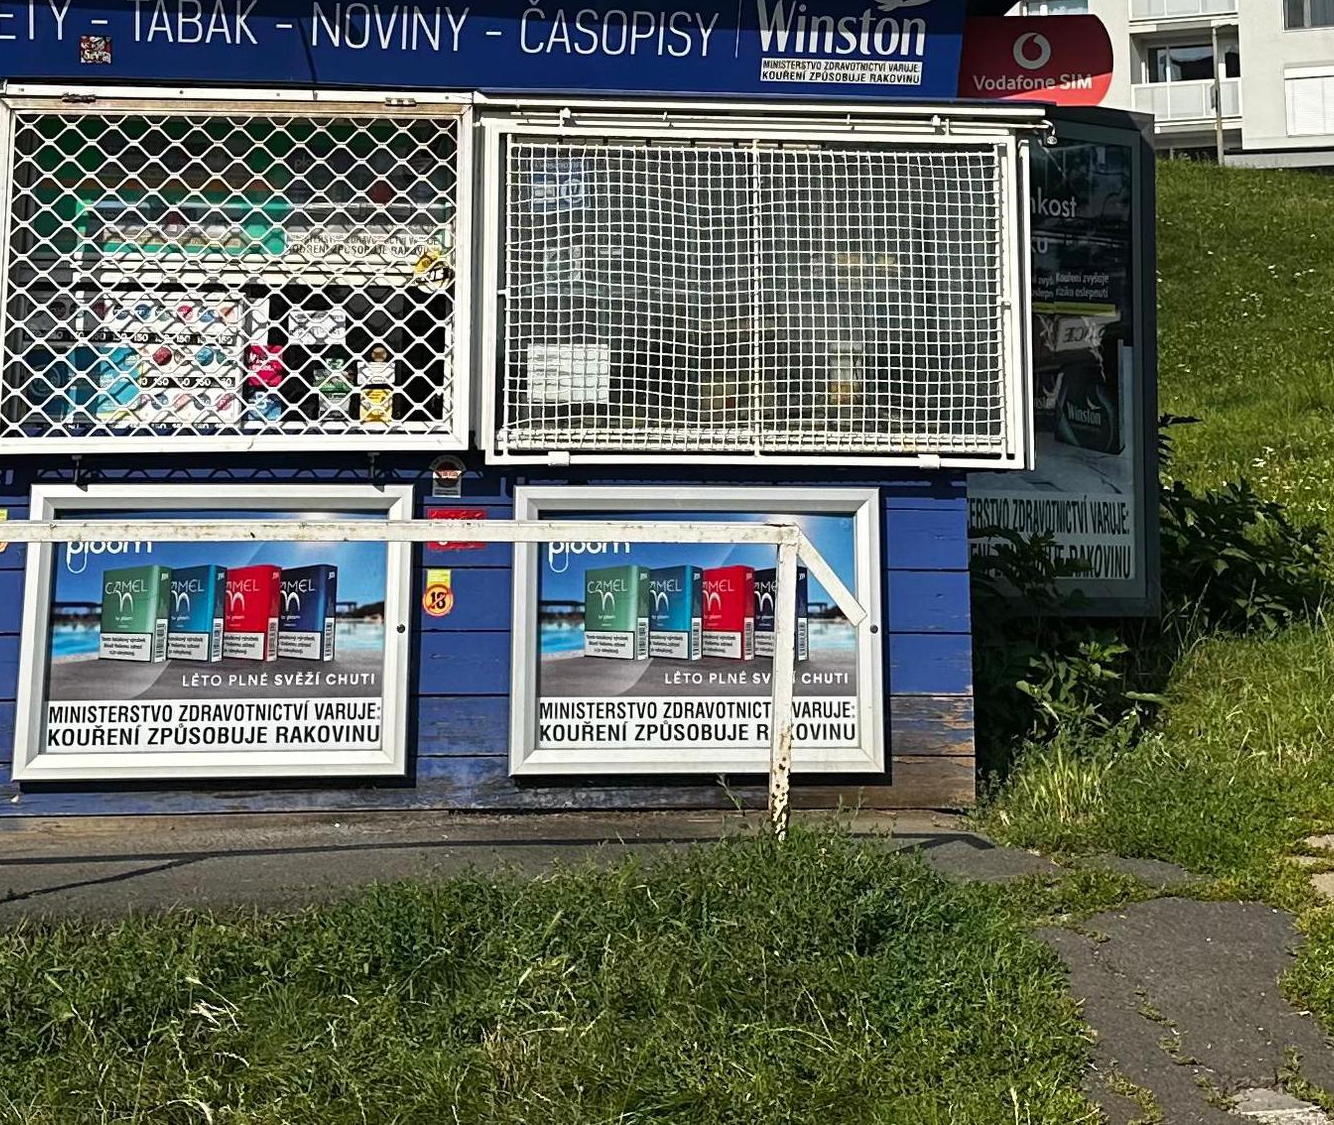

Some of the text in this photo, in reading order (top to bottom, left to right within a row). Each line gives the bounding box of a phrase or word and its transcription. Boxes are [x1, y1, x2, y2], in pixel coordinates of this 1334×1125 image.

[311, 1, 470, 52] NOVINY
[763, 60, 822, 71] MINISTERSTVO
[762, 70, 806, 81] KOUŘENÍ
[869, 73, 920, 84] RAKOVINU
[973, 74, 1092, 91] Vodafone SIM
[1067, 401, 1101, 426] Winston
[1012, 495, 1088, 534] ZDRAVOTNICTVÍ
[1090, 501, 1130, 535] VARUJE:
[105, 579, 148, 595] CAMEL
[170, 578, 205, 593] AMEL
[226, 579, 260, 593] AMEL
[280, 578, 316, 594] AMEL
[587, 579, 628, 594] CAMEL
[649, 578, 683, 593] AMEL
[702, 578, 735, 593] AMEL
[430, 591, 446, 609] 18
[182, 670, 376, 687] LÉTO PLNÉ SVĚŽÍ CHUTI
[664, 671, 703, 684] LÉTO
[709, 670, 747, 684] PLNÉ
[801, 672, 849, 684] CHUTI
[49, 700, 382, 724] MINISTERSTVO ZDRAVOTNICTVÍ VARUJE:
[539, 701, 856, 719] MINISTERSTVO ZDRAVOTNICT VARUJE:
[47, 722, 381, 747] KOUŘENÍ ZPŮSOBUJE RAKOVINU
[539, 719, 856, 742] KOUŘENÍ ZPŮSOBUJE ROVINU
